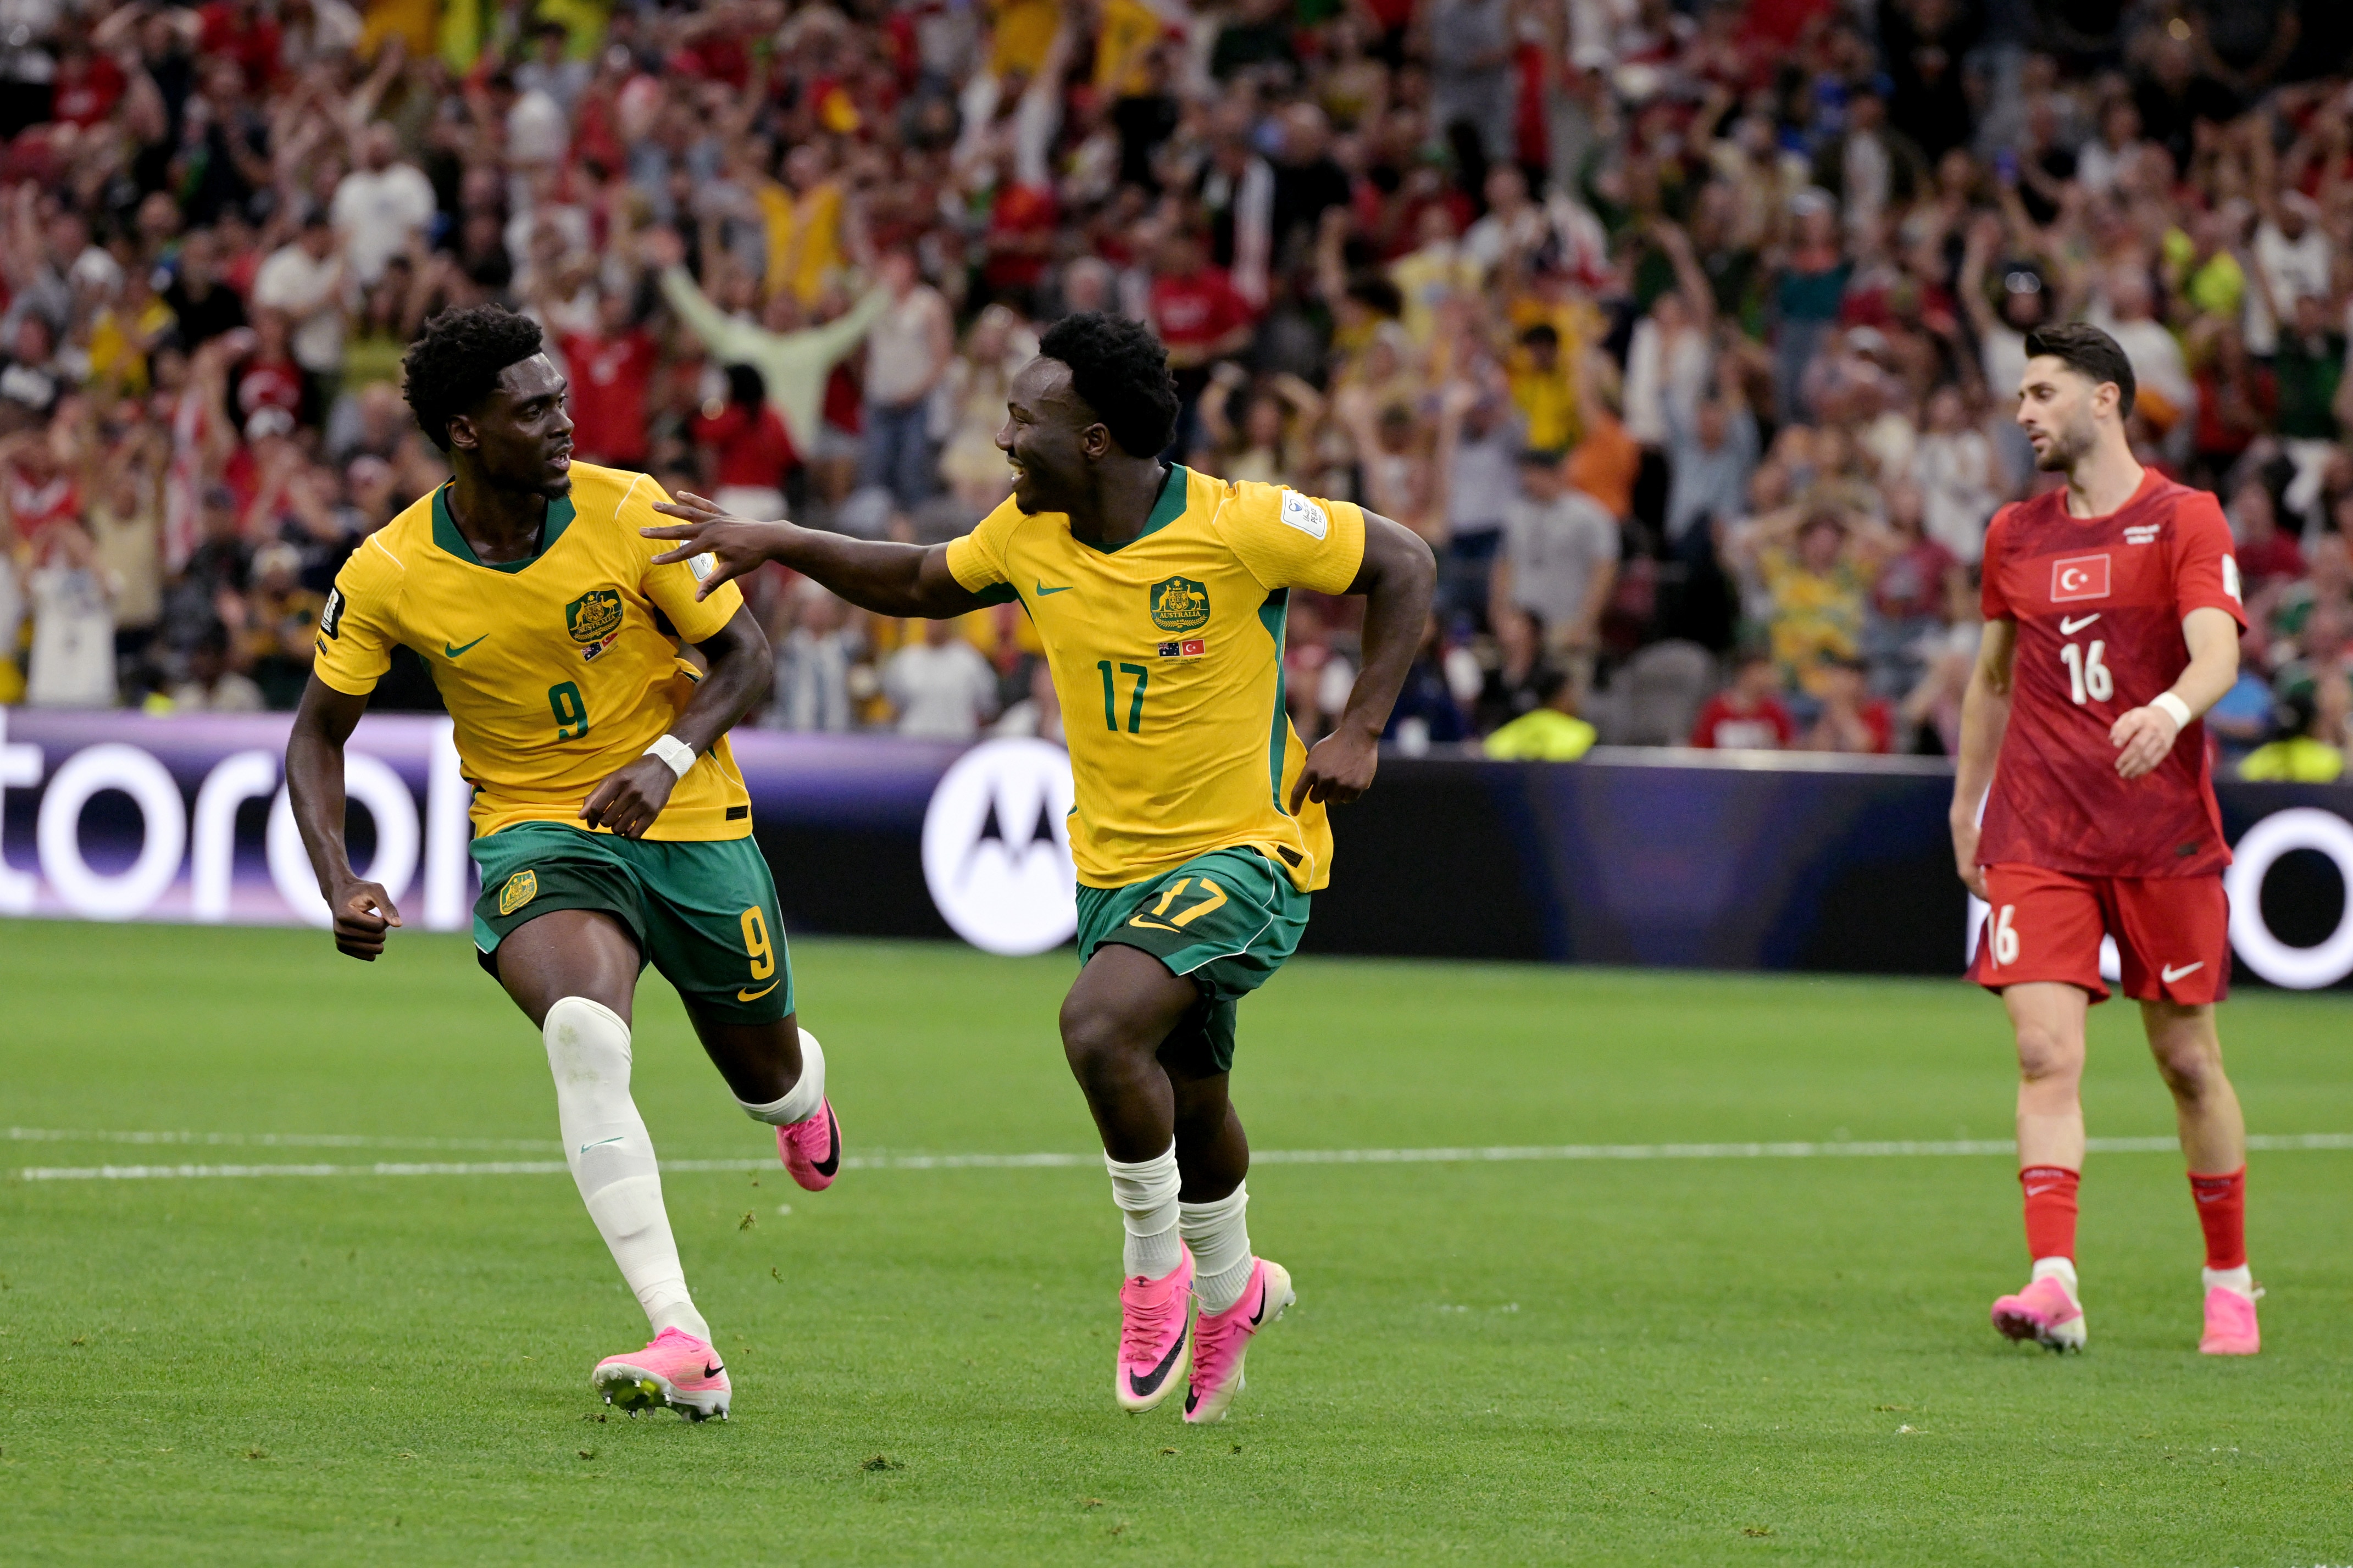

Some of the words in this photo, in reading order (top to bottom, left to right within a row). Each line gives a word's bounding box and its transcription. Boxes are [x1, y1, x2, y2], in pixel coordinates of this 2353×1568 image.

[579, 615, 616, 633] AUSTRALIA
[1097, 660, 1148, 734] 17
[2060, 640, 2114, 705] 16
[548, 681, 589, 741] 9
[1151, 877, 1228, 927] 17
[740, 905, 775, 980] 9
